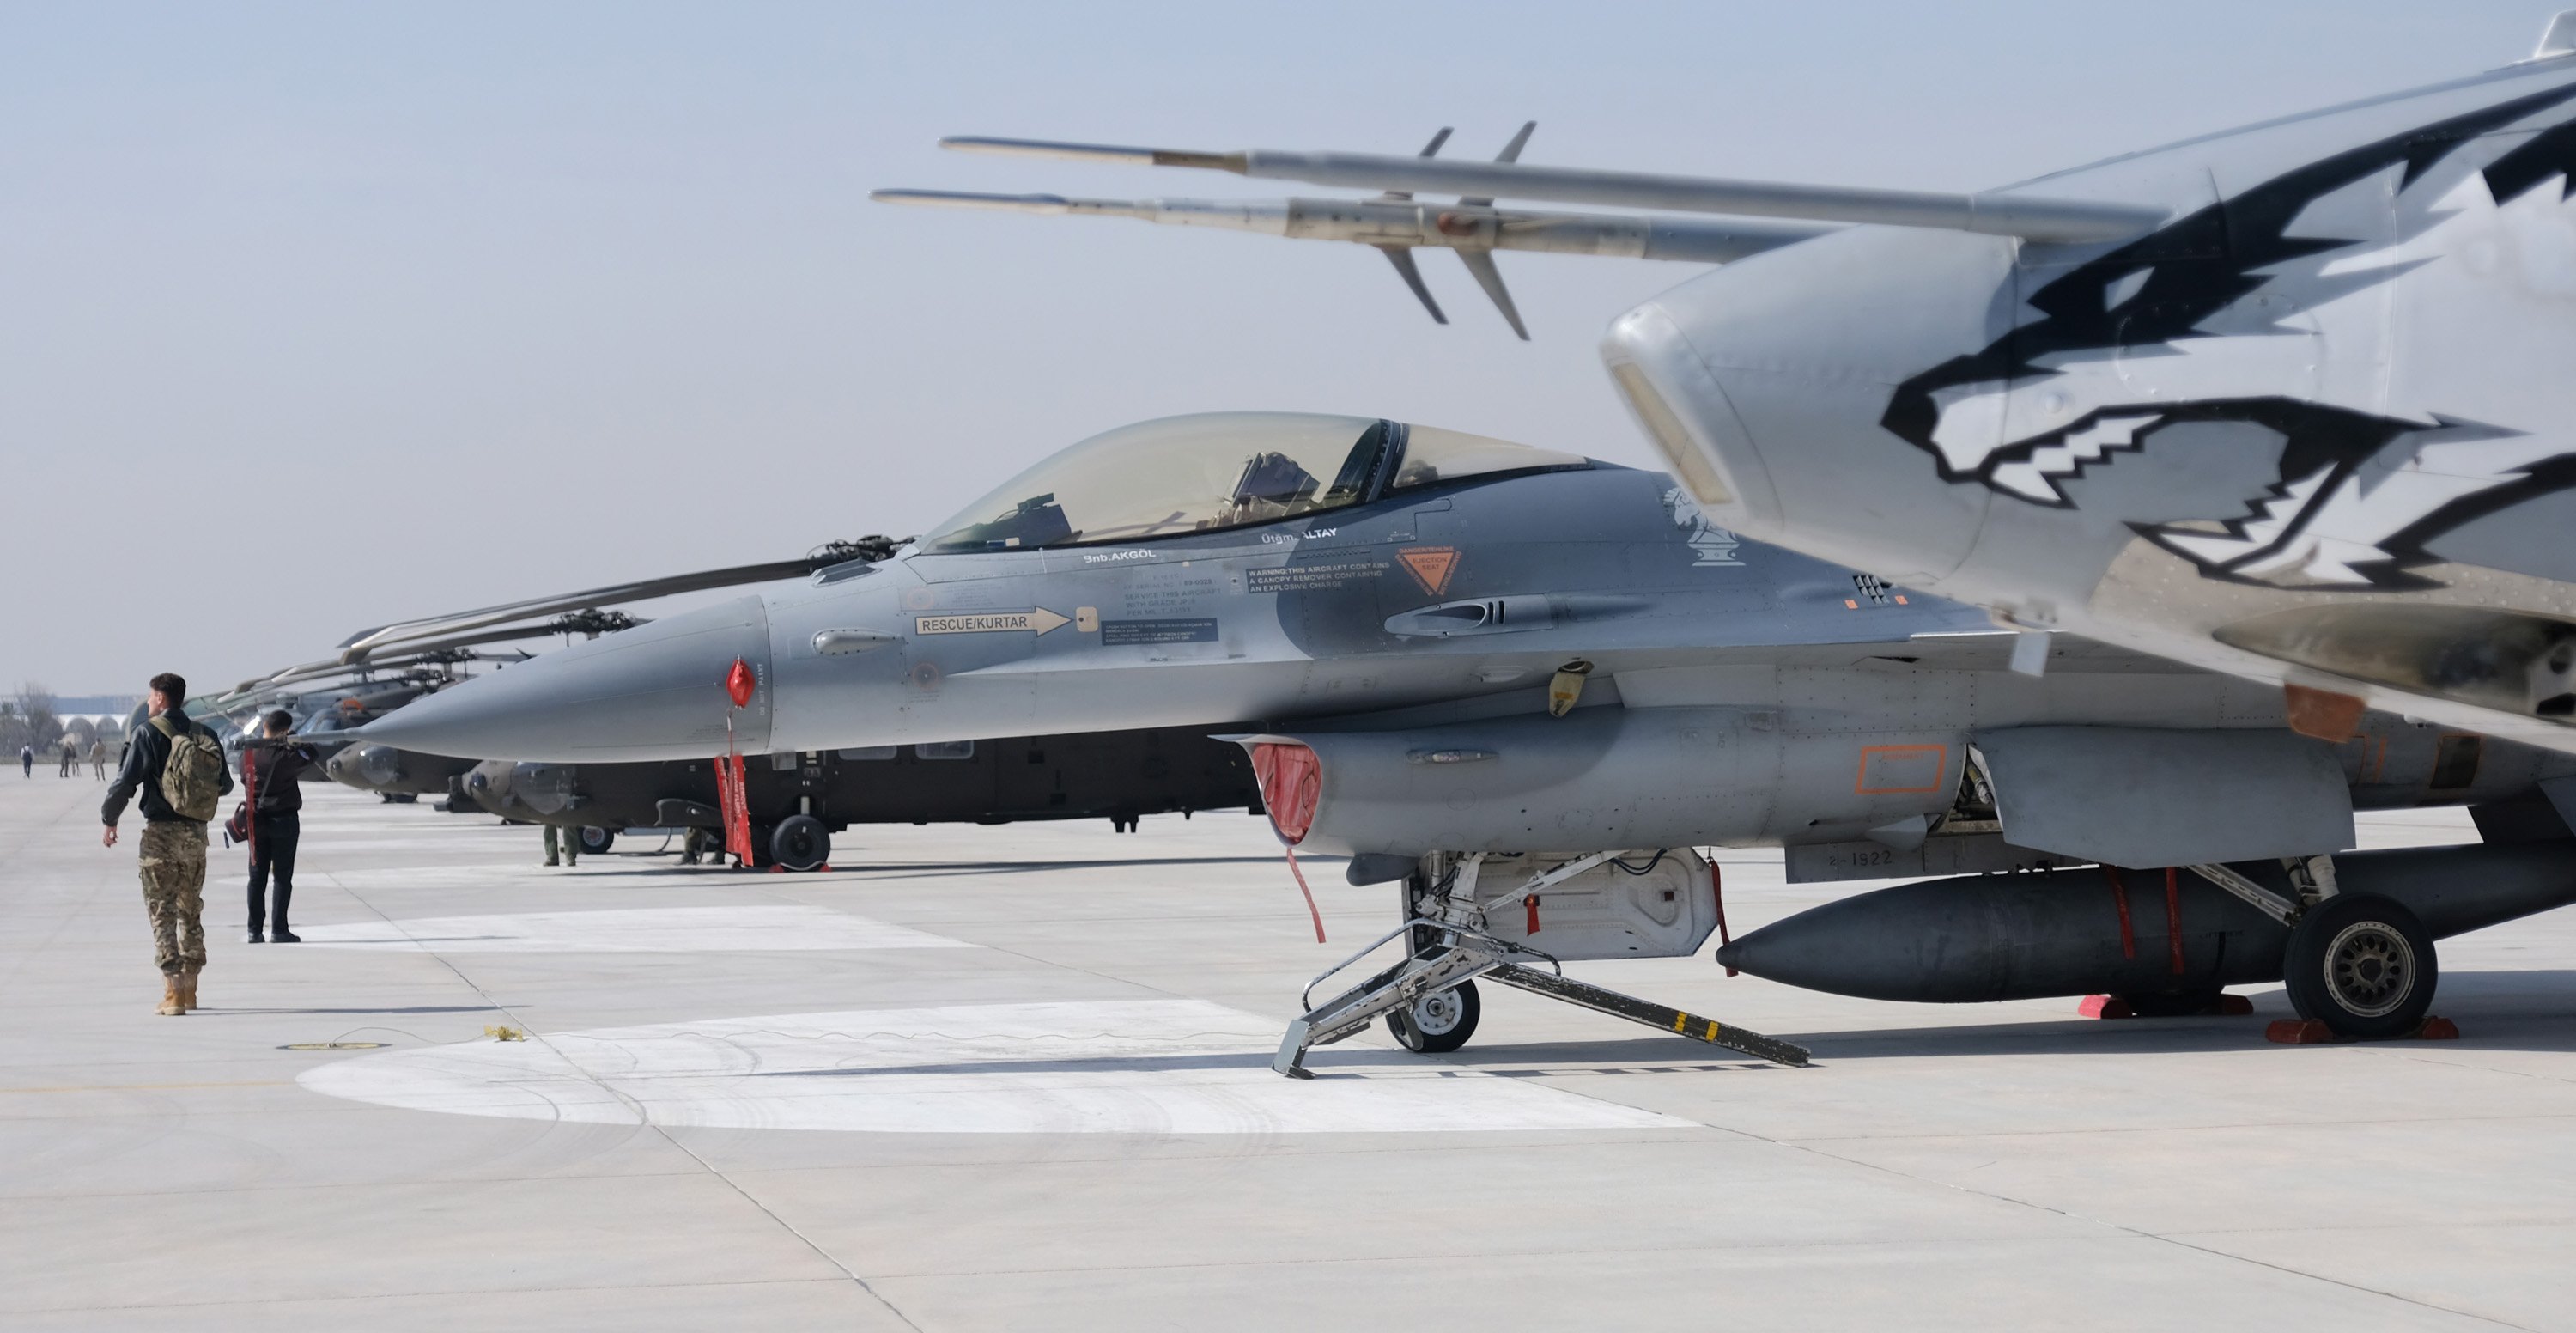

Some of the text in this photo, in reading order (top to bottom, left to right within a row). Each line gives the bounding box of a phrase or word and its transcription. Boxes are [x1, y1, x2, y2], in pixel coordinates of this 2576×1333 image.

[1308, 564, 1347, 573] AIRCRAFT
[1350, 562, 1390, 570] CONTAINS
[1293, 574, 1333, 582] REMOVER
[922, 616, 1027, 631] RESCUE/KURTAR
